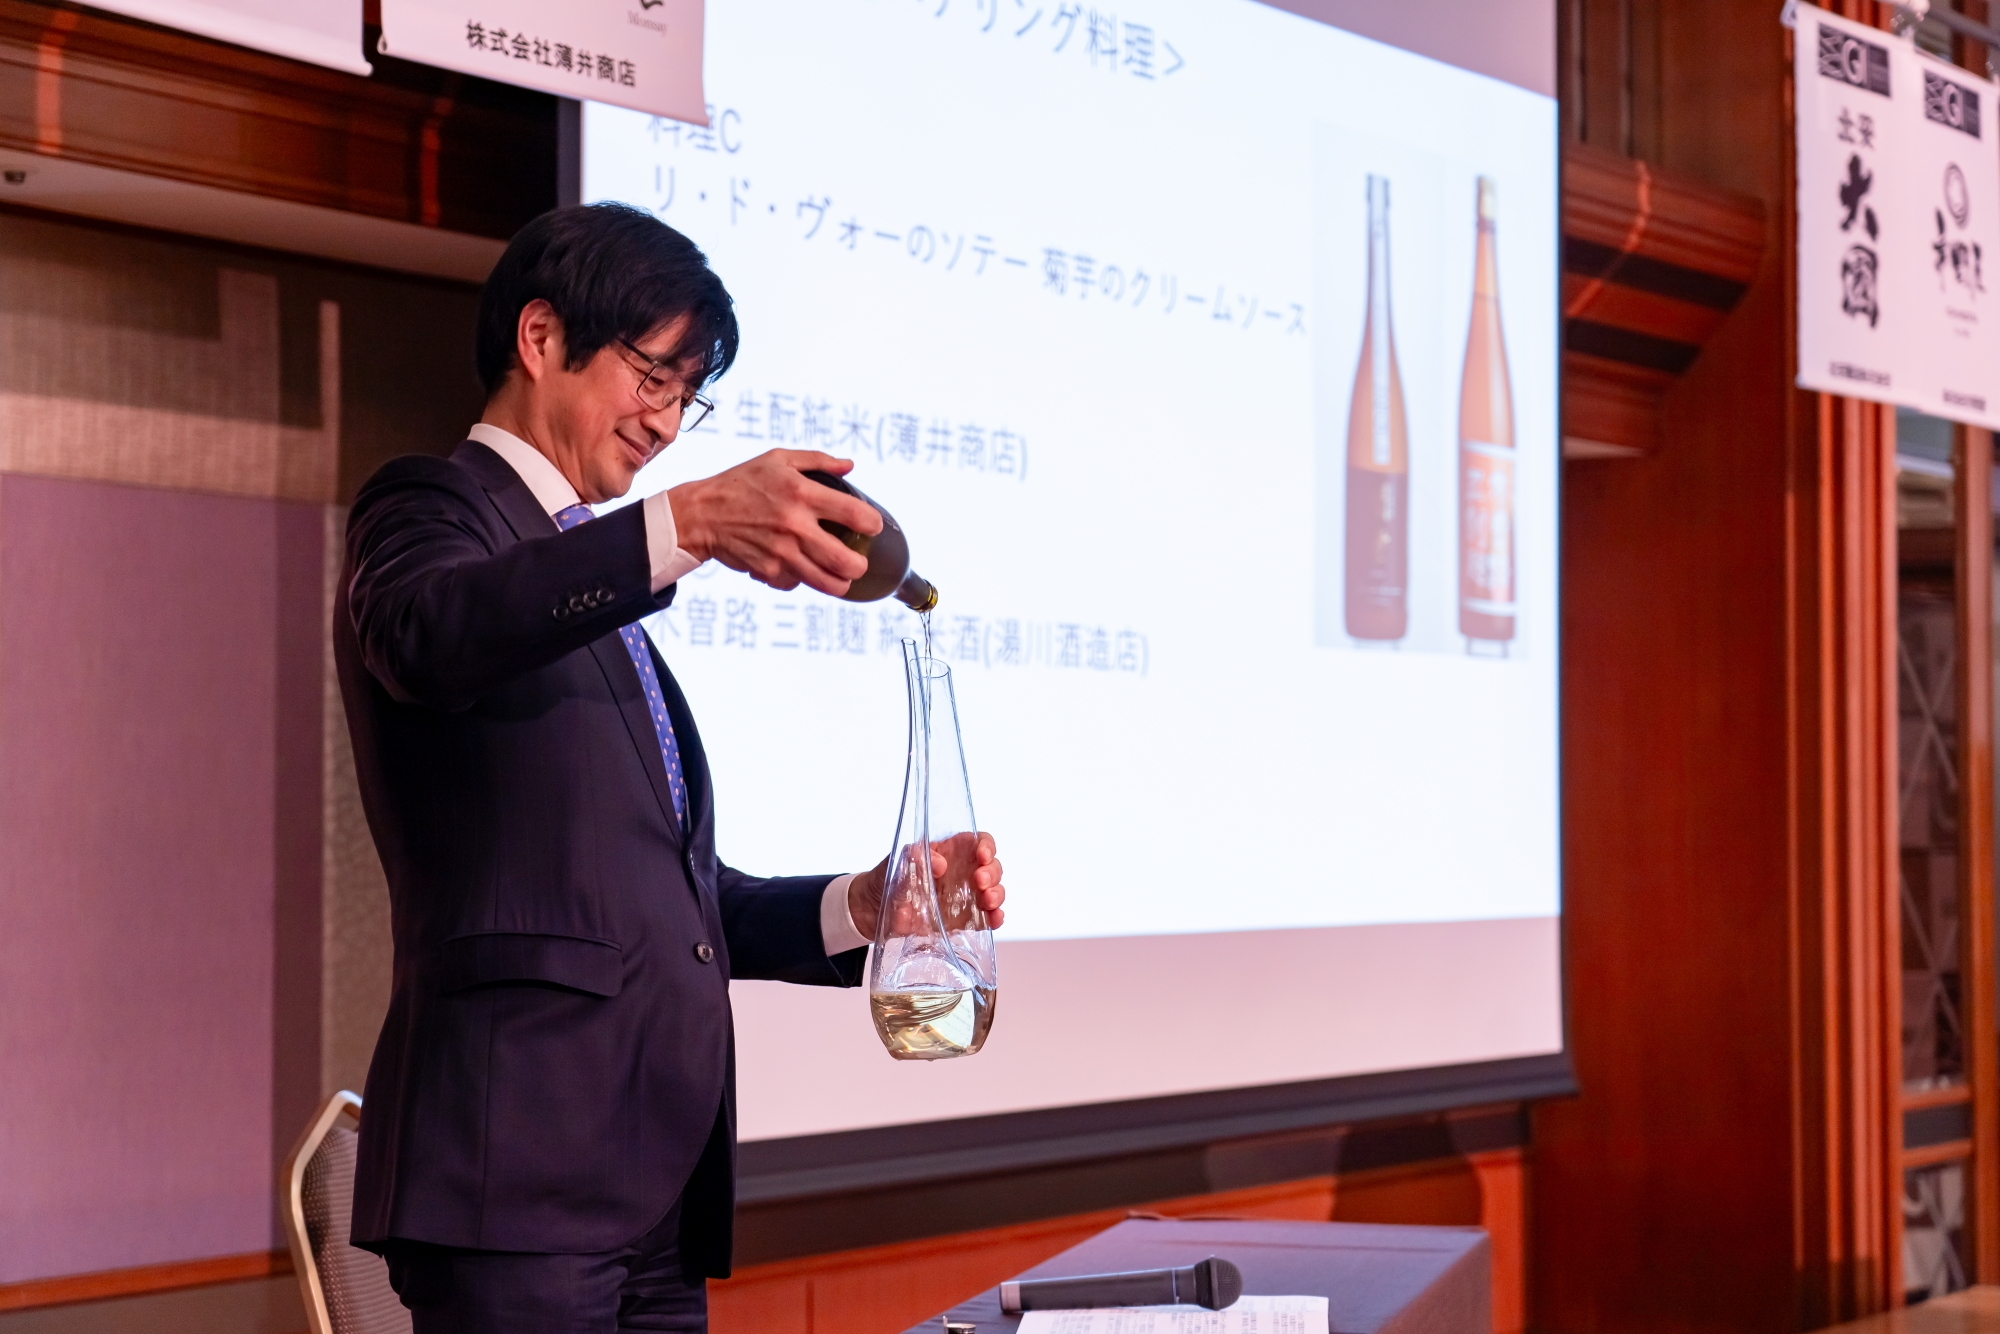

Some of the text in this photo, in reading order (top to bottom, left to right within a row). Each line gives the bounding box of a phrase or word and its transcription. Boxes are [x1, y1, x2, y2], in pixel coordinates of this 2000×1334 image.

[465, 20, 637, 88] 株式会社薄井商店
[1041, 247, 1307, 336] 菊芋のクリームソース
